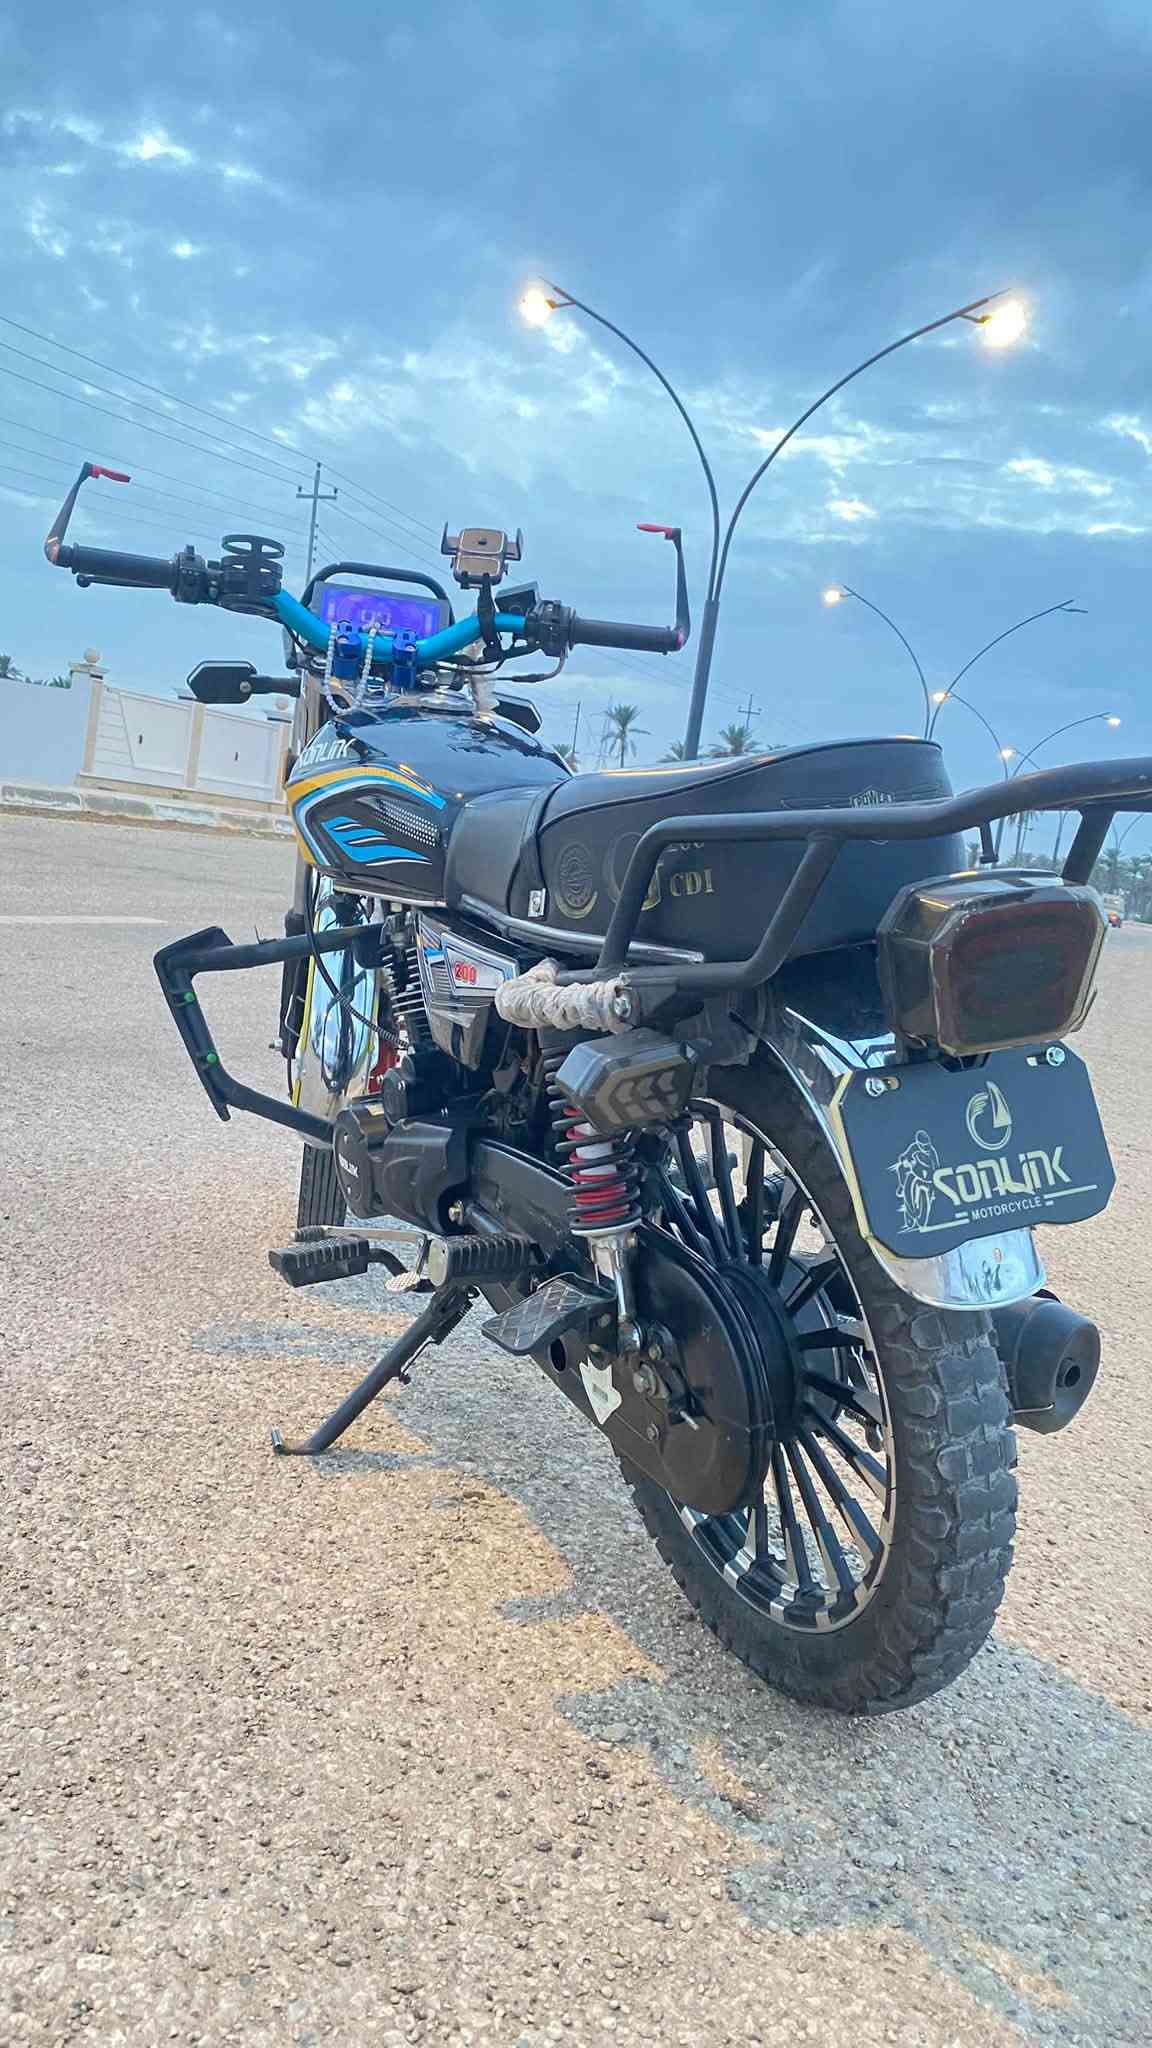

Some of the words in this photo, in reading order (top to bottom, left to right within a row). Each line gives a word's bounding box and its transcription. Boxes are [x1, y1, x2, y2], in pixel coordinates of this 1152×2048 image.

[670, 868, 714, 897] CDI
[454, 961, 478, 985] 200
[971, 1196, 1043, 1220] MOTORCYCLE
